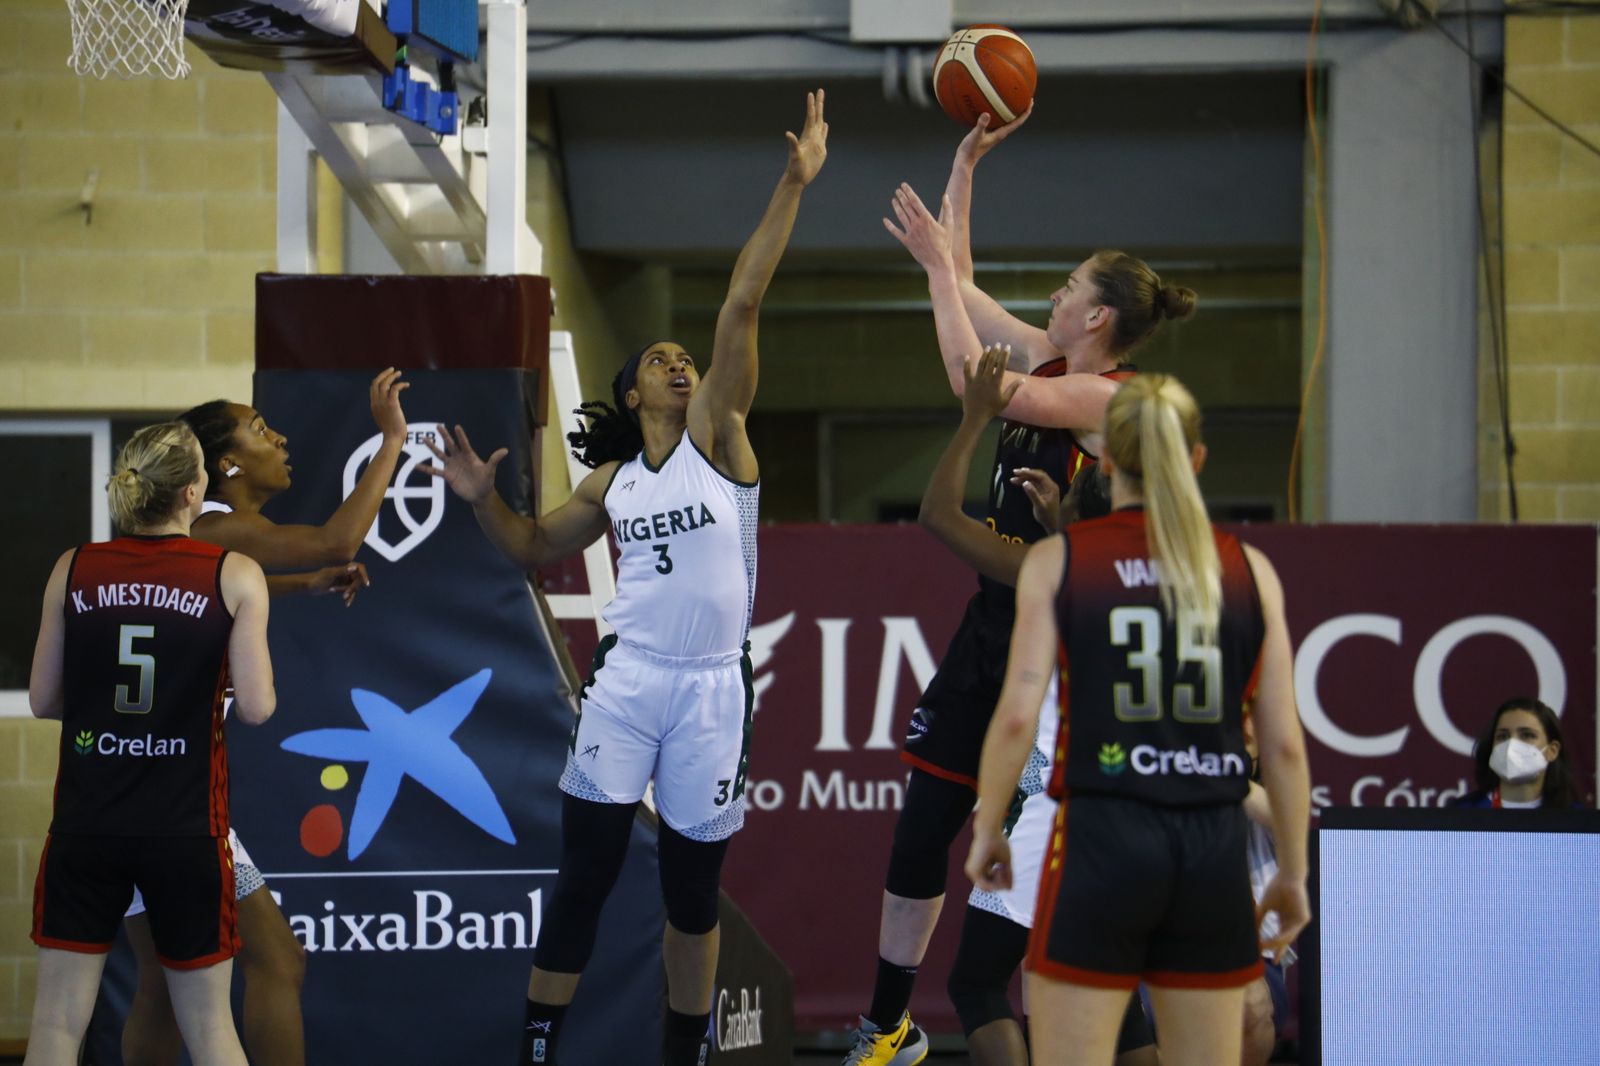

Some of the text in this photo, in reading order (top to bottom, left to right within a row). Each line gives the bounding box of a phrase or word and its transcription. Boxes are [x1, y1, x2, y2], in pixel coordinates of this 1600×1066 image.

[405, 431, 436, 445] FEB
[613, 502, 716, 543] NIGERIA
[652, 543, 673, 575] 3
[72, 583, 209, 618] K. MESTDAGH
[114, 624, 156, 714] 5
[1109, 606, 1224, 723] 35
[97, 732, 187, 757] Crelan
[1130, 744, 1246, 776] Crelan
[713, 779, 731, 807] 3
